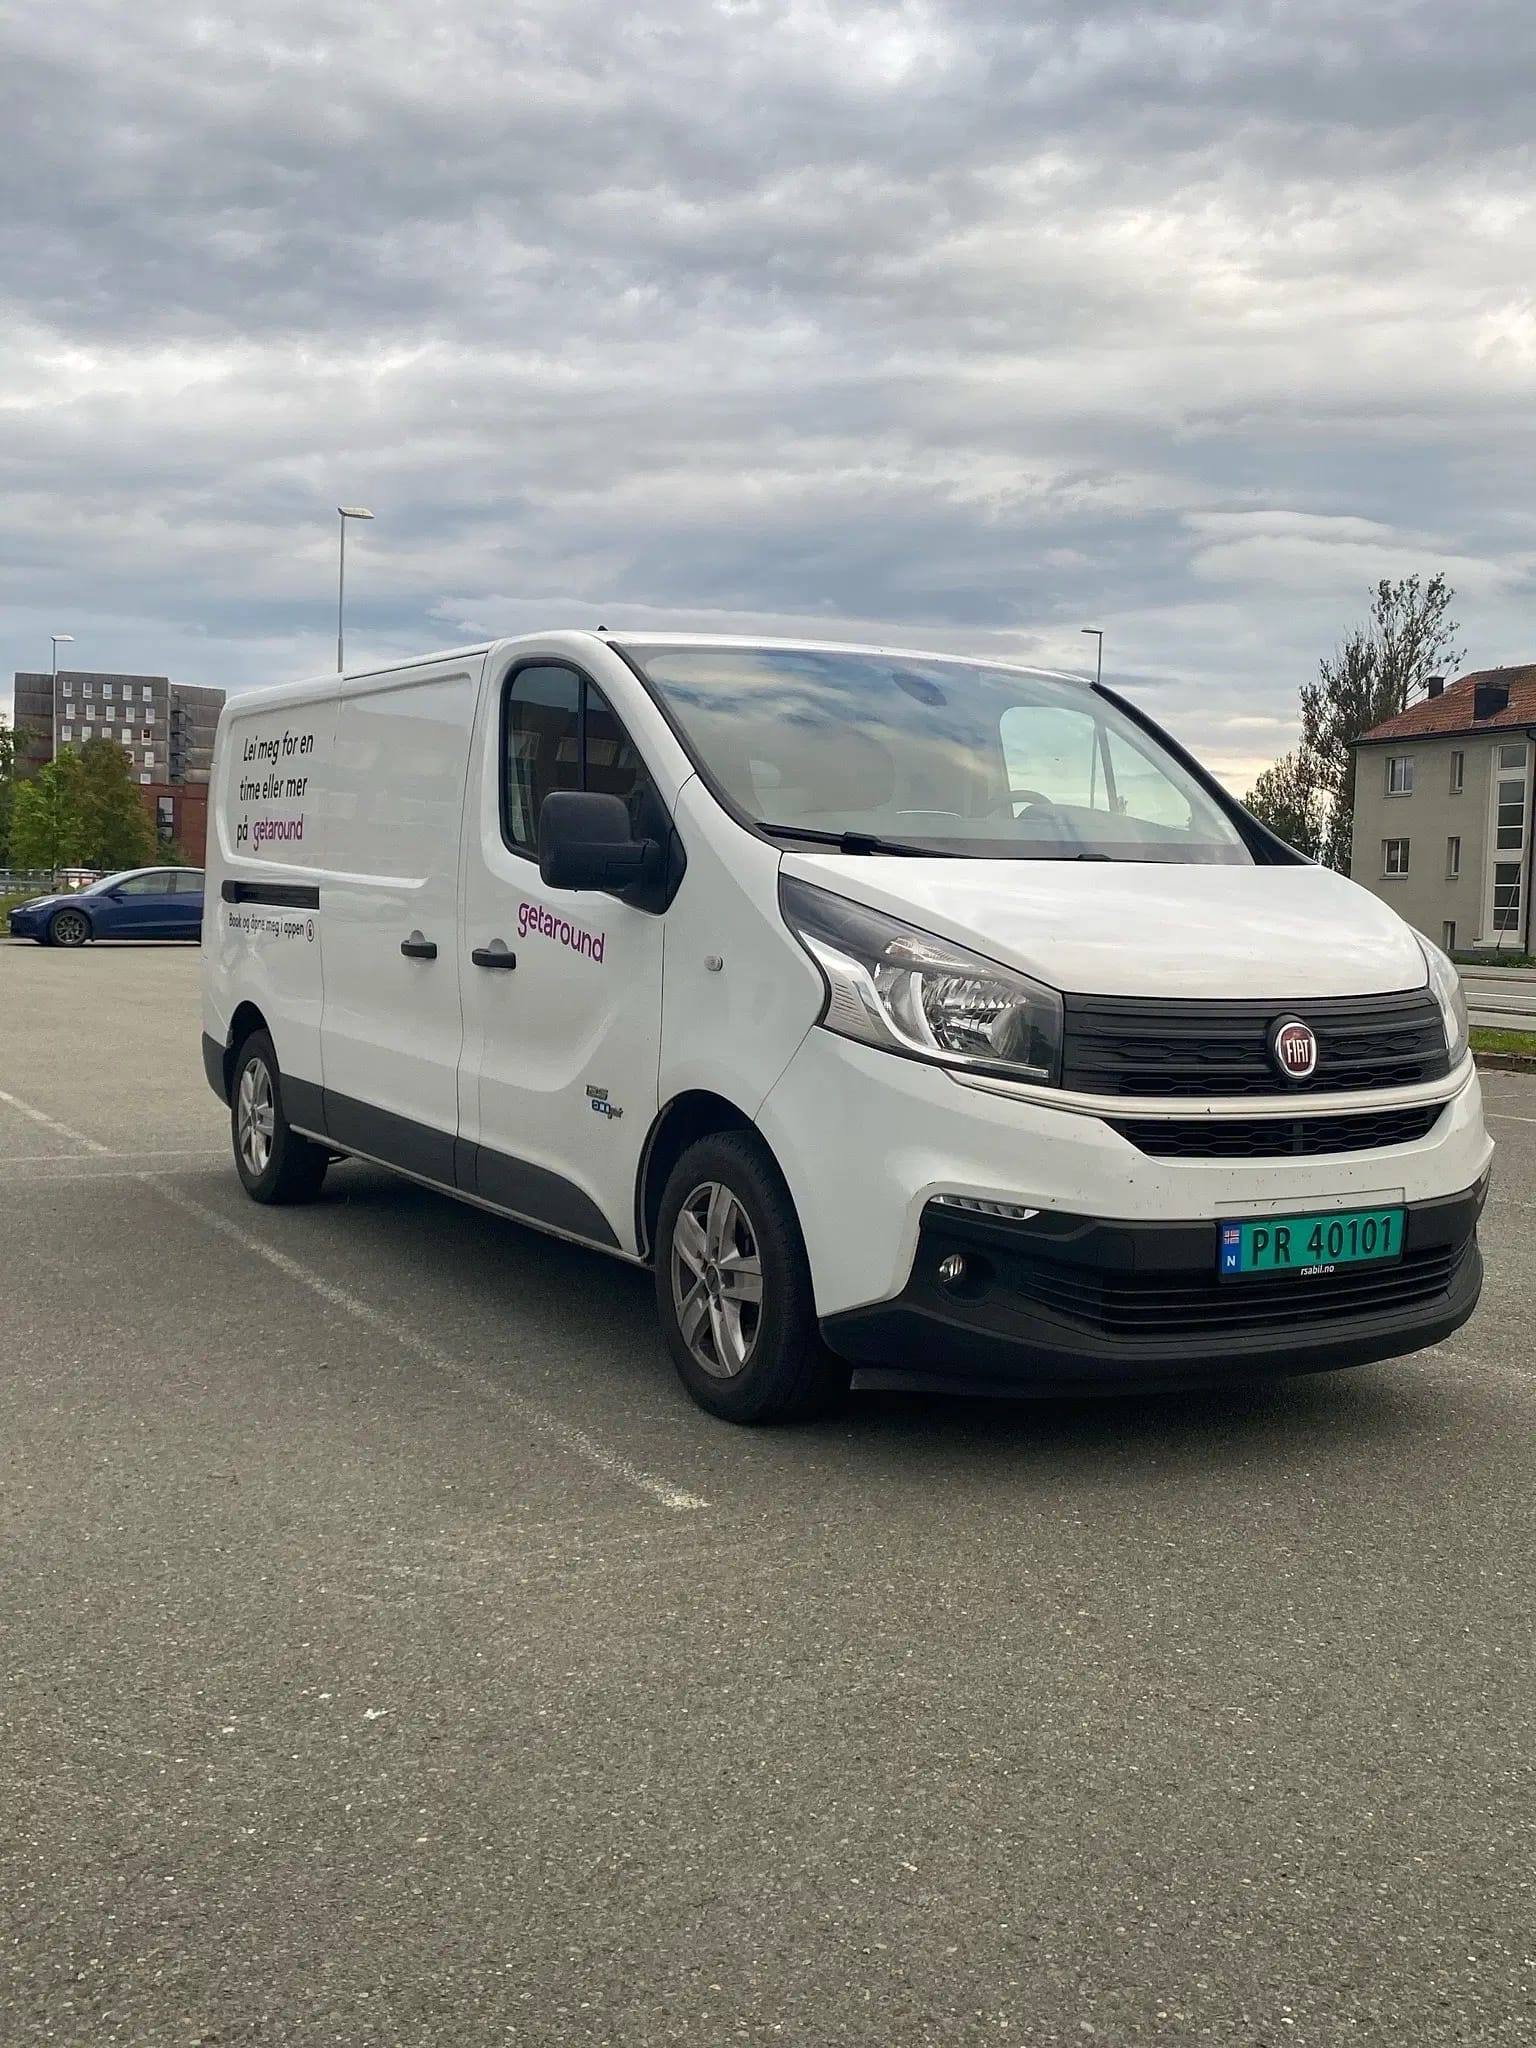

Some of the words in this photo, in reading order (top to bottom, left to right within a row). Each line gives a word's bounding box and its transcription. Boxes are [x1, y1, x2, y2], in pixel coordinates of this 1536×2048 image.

[243, 735, 258, 762] Lei
[258, 739, 280, 765] meg
[281, 730, 298, 756] for
[300, 734, 314, 754] en
[240, 776, 260, 801] time
[262, 773, 284, 799] eller
[286, 777, 308, 797] mer
[236, 814, 248, 848] på
[252, 813, 304, 851] getaround
[229, 912, 242, 928] Book
[243, 917, 250, 933] og
[266, 920, 280, 937] meg
[284, 922, 304, 939] appen
[517, 902, 606, 963] getaround
[1285, 1038, 1310, 1064] FIAT
[1252, 1226, 1292, 1267] PR
[1306, 1216, 1393, 1260] 40101
[1226, 1255, 1236, 1267] N
[1300, 1263, 1335, 1277] rsabil.no
